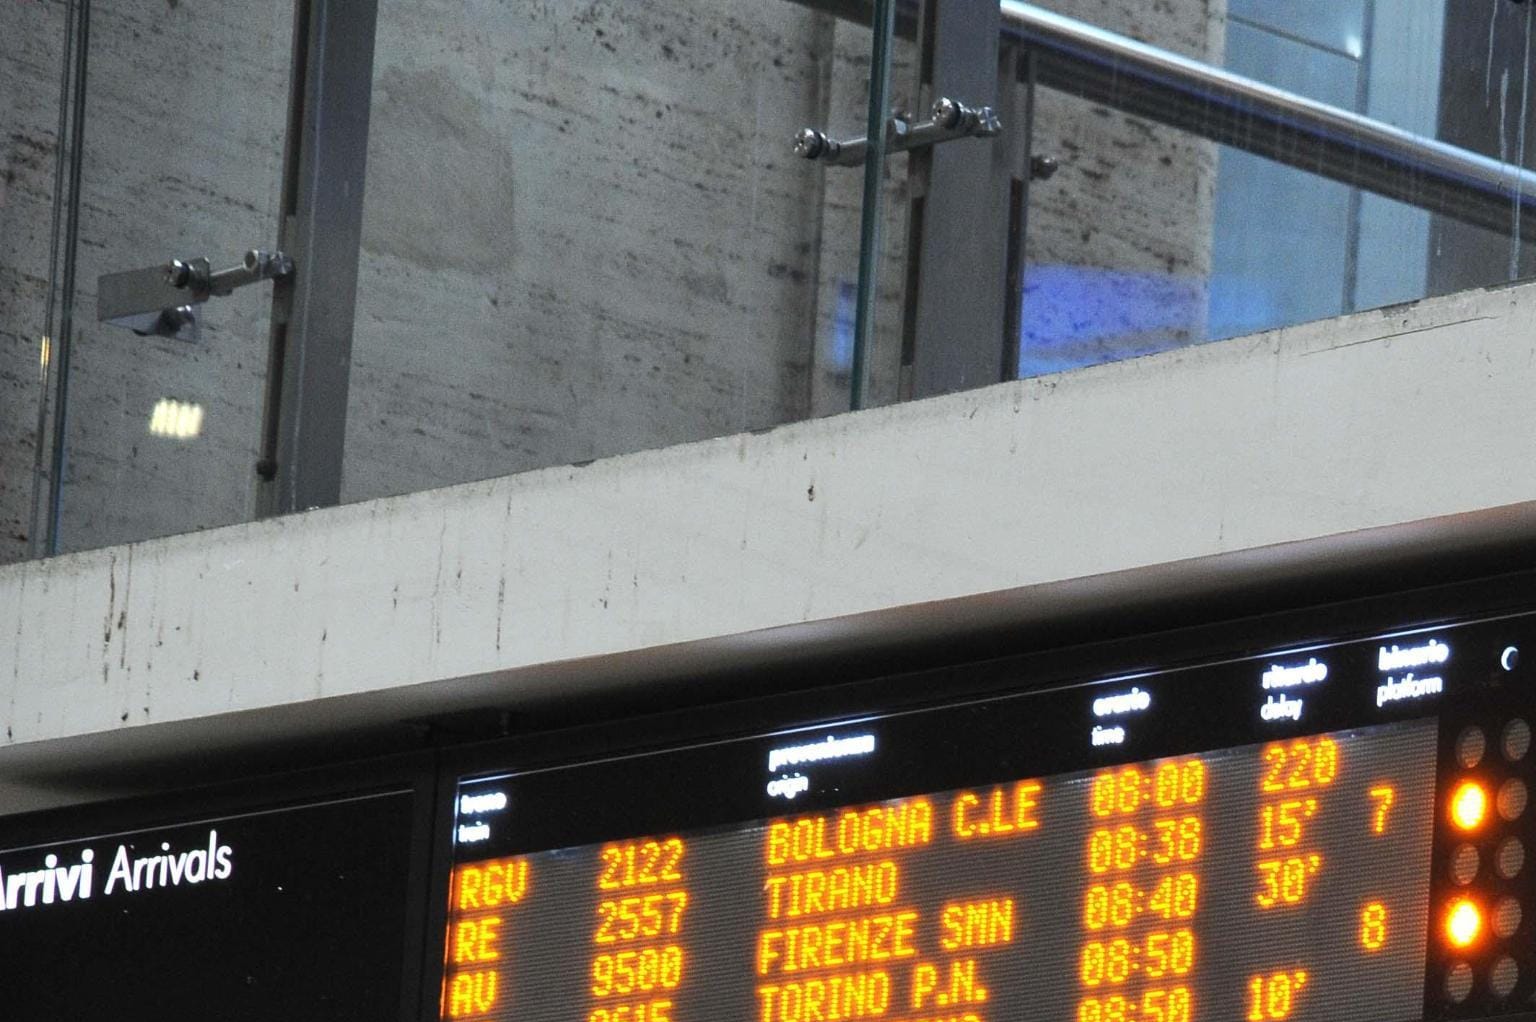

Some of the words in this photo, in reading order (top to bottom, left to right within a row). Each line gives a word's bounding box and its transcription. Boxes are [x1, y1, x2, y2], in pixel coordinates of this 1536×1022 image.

[1376, 674, 1442, 707] platform
[0, 849, 94, 910] rrivi
[104, 830, 232, 894] Arrivals
[455, 916, 501, 963] RE
[595, 891, 687, 943] 2557
[765, 861, 897, 919] TIRANO
[1089, 816, 1201, 873] 08:38
[1370, 788, 1393, 833] 7
[459, 861, 527, 910] RGV
[599, 839, 683, 890] 2122
[767, 801, 932, 865] BOLOGNA
[955, 785, 1041, 837] C.LE
[1091, 759, 1204, 817] 08:00
[1262, 739, 1337, 792] 220
[450, 970, 497, 1016] AV
[592, 945, 682, 997] 9500
[760, 912, 917, 974] FIRENZE
[942, 899, 1013, 949] SMN
[1085, 873, 1197, 930] 08:40
[913, 959, 987, 1009] P.N.
[1081, 930, 1194, 986] 08:50
[1361, 904, 1386, 949] 8
